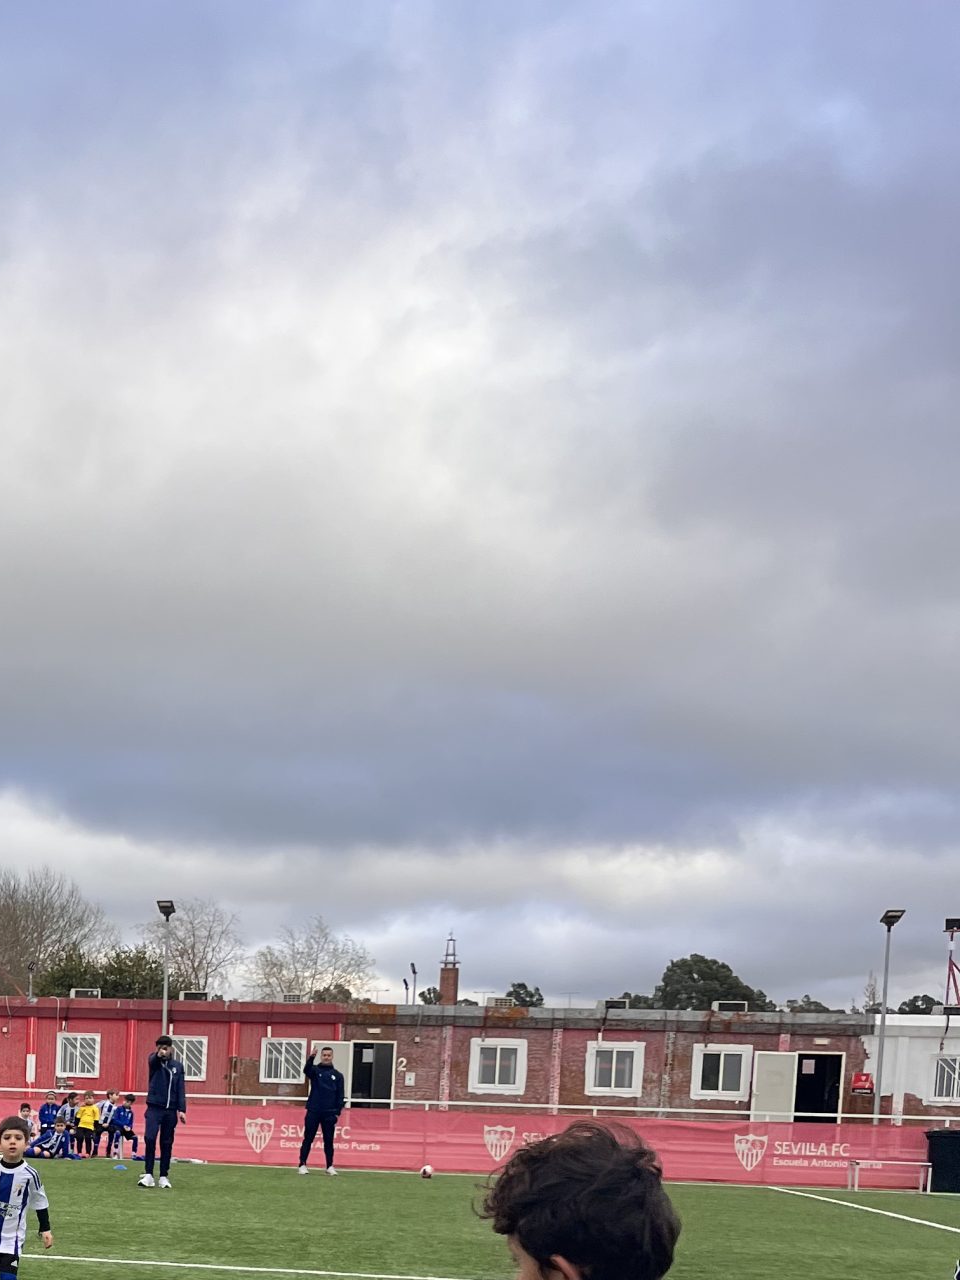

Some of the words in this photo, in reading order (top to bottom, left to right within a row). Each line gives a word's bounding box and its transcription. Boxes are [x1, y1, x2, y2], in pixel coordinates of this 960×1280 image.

[396, 1057, 407, 1071] 2
[334, 1126, 351, 1139] FC
[351, 1141, 381, 1151] Puerta
[773, 1141, 828, 1156] SEVILLA
[831, 1143, 850, 1157] FC
[773, 1157, 809, 1167] Escuela
[810, 1158, 848, 1168] Antonio
